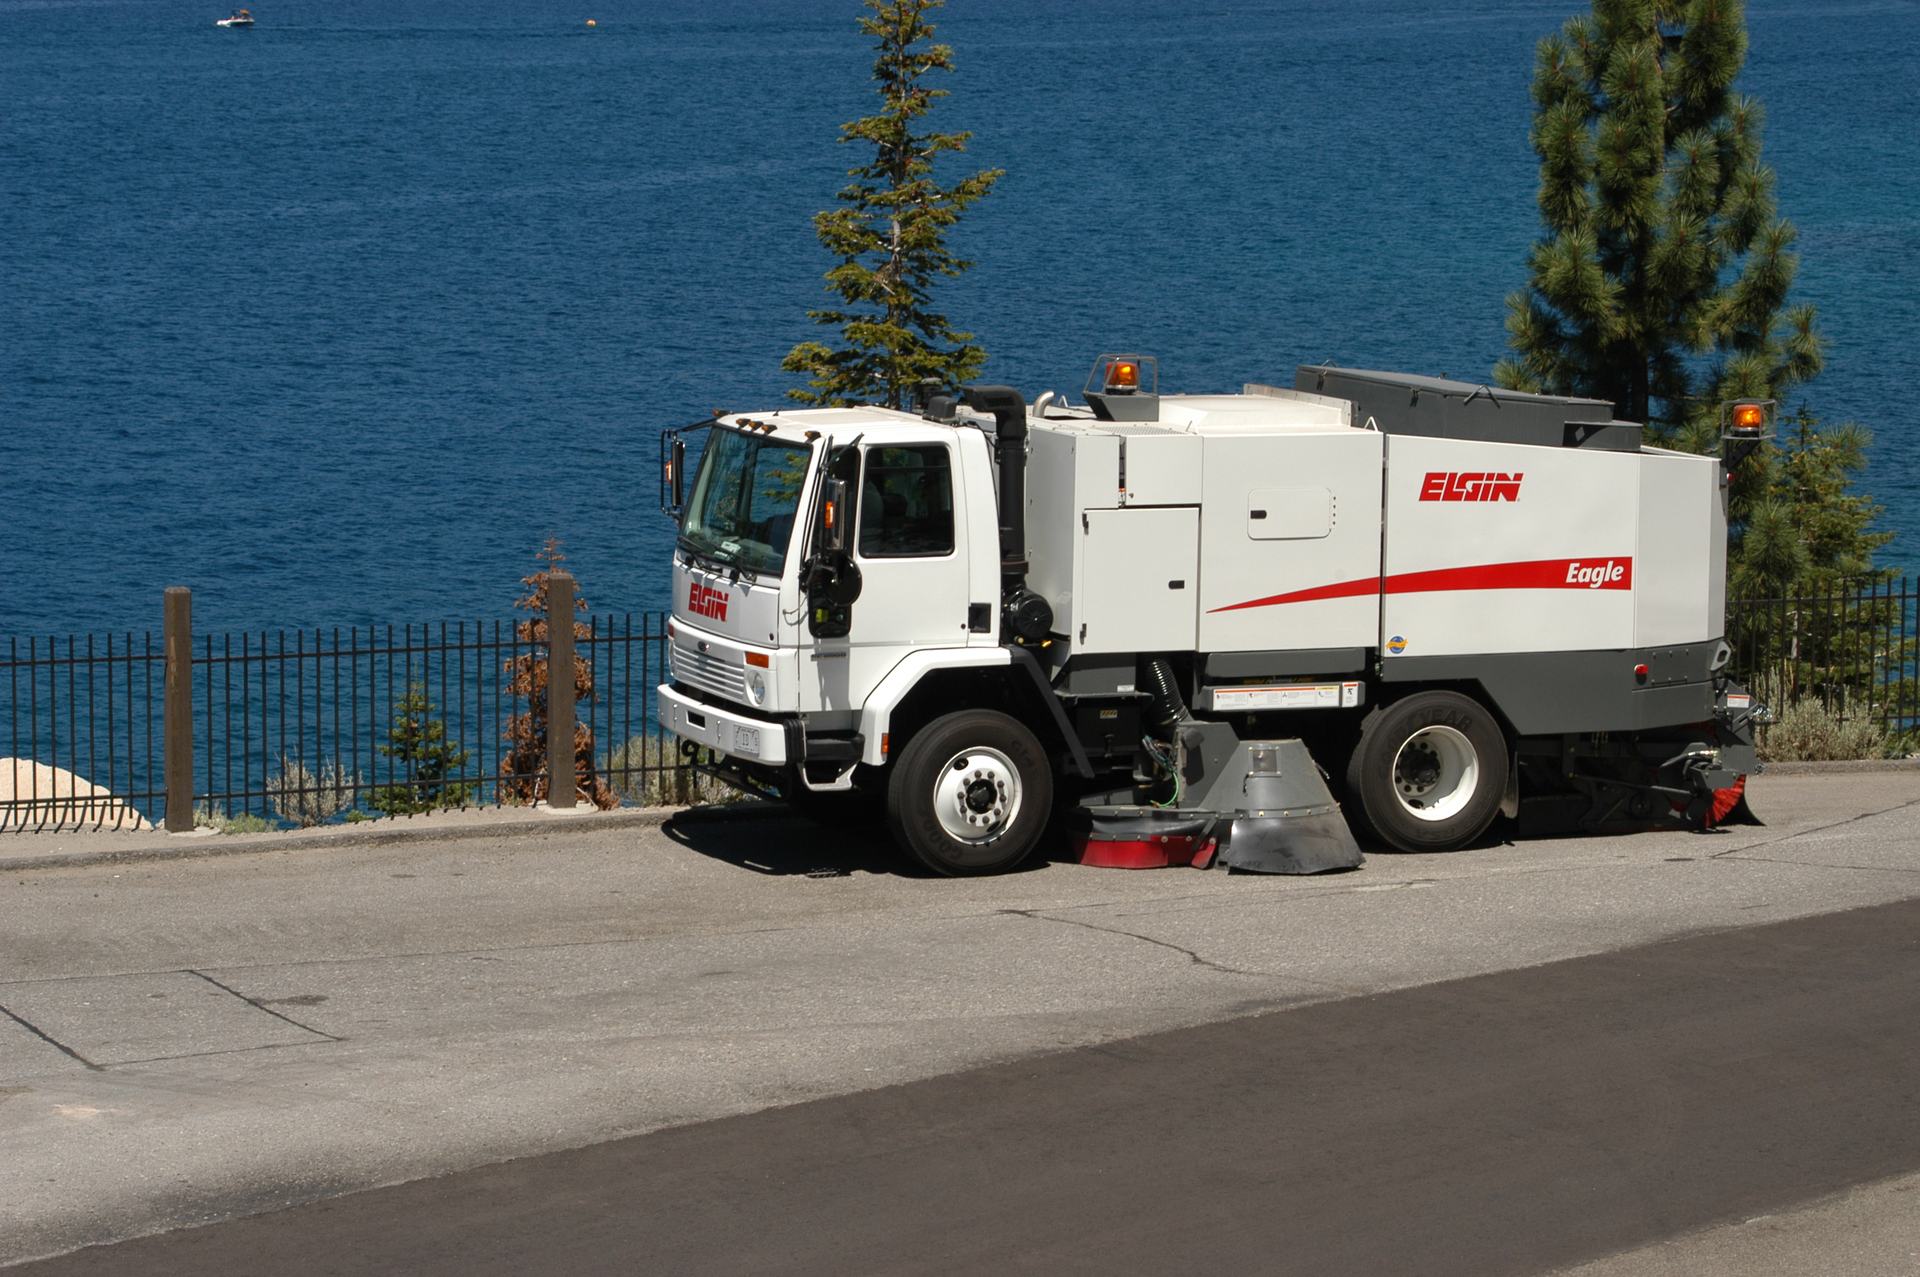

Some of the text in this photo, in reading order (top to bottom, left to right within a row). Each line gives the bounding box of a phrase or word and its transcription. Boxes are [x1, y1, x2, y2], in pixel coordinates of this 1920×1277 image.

[1418, 472, 1524, 502] ELGIN
[1566, 561, 1624, 588] Eagle
[688, 582, 729, 622] ELGIN
